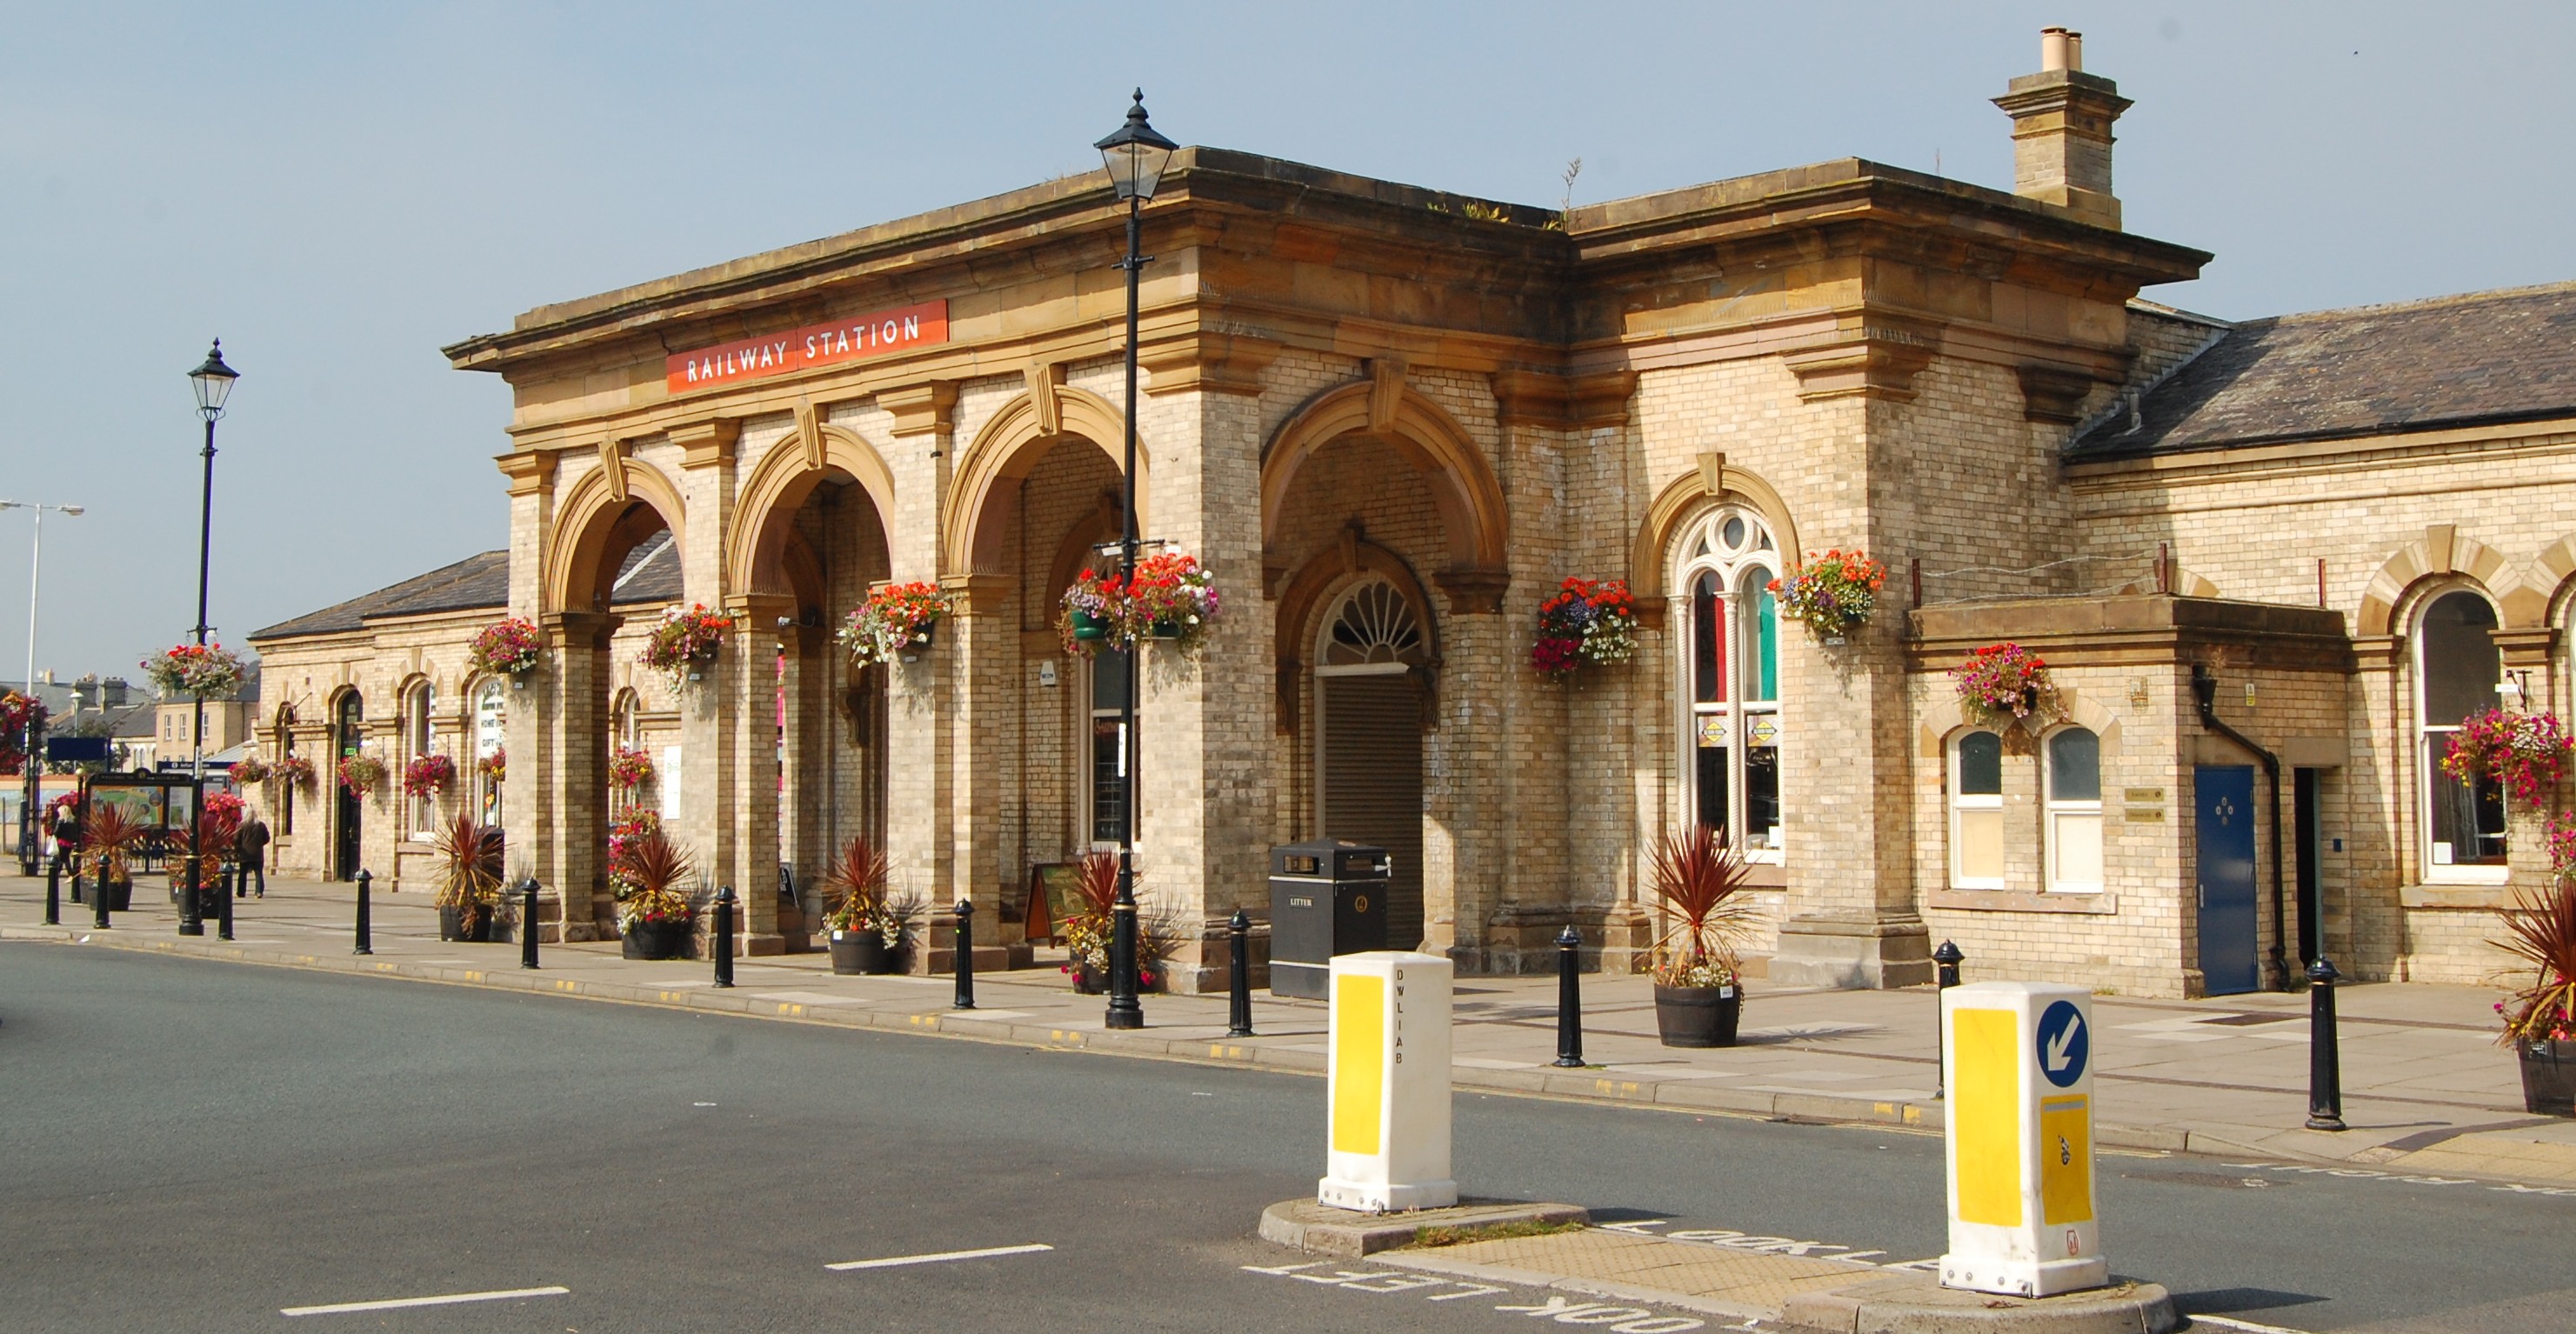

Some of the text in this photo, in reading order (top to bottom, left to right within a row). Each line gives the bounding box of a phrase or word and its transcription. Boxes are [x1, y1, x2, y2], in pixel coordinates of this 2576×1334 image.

[687, 315, 919, 383] RAILWAY STATION
[1290, 897, 1312, 906] LITTER
[1599, 1220, 1850, 1256] LOOK
[1238, 1260, 1510, 1301] LEFT
